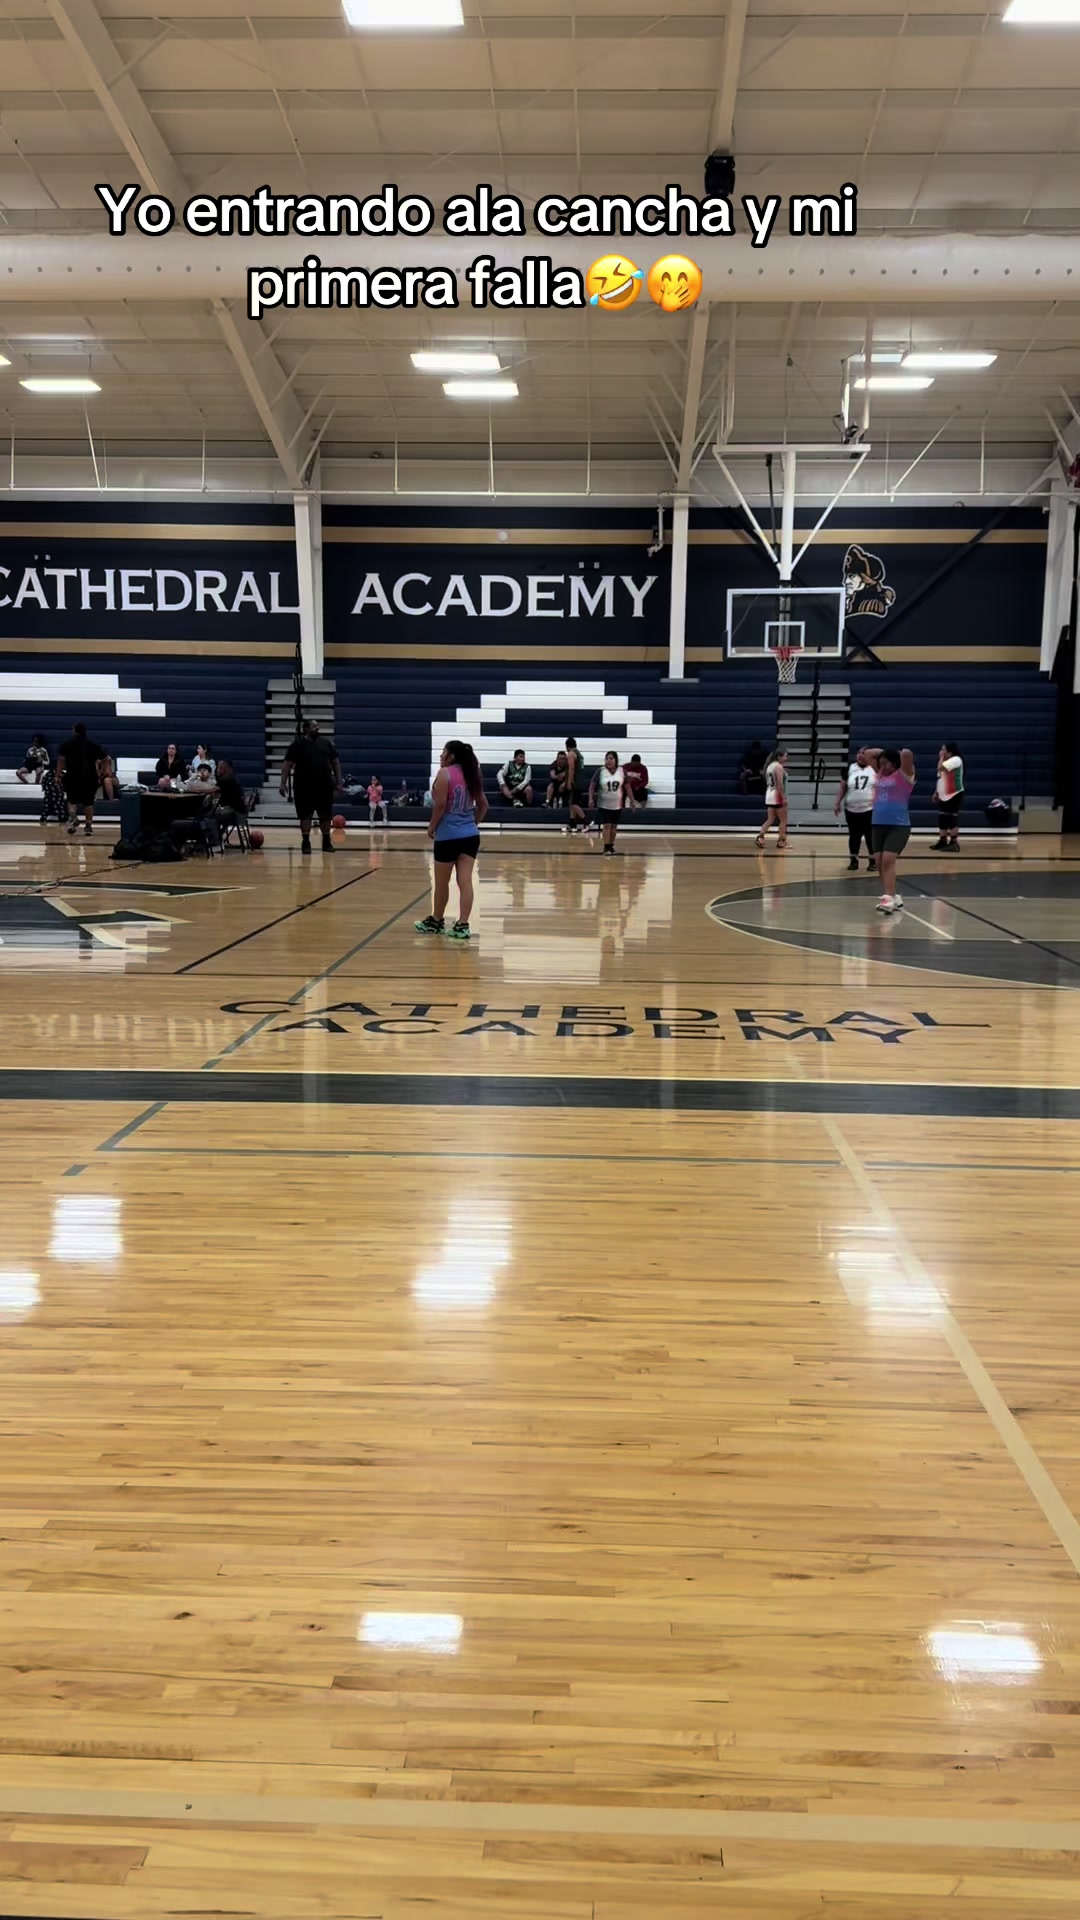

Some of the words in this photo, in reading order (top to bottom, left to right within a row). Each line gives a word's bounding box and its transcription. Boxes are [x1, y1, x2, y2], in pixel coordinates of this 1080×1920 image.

[350, 572, 660, 618] ACADEMY
[854, 775, 870, 791] 17
[220, 1000, 992, 1029] CATHEDRAL
[267, 1017, 918, 1044] ACADEMY
